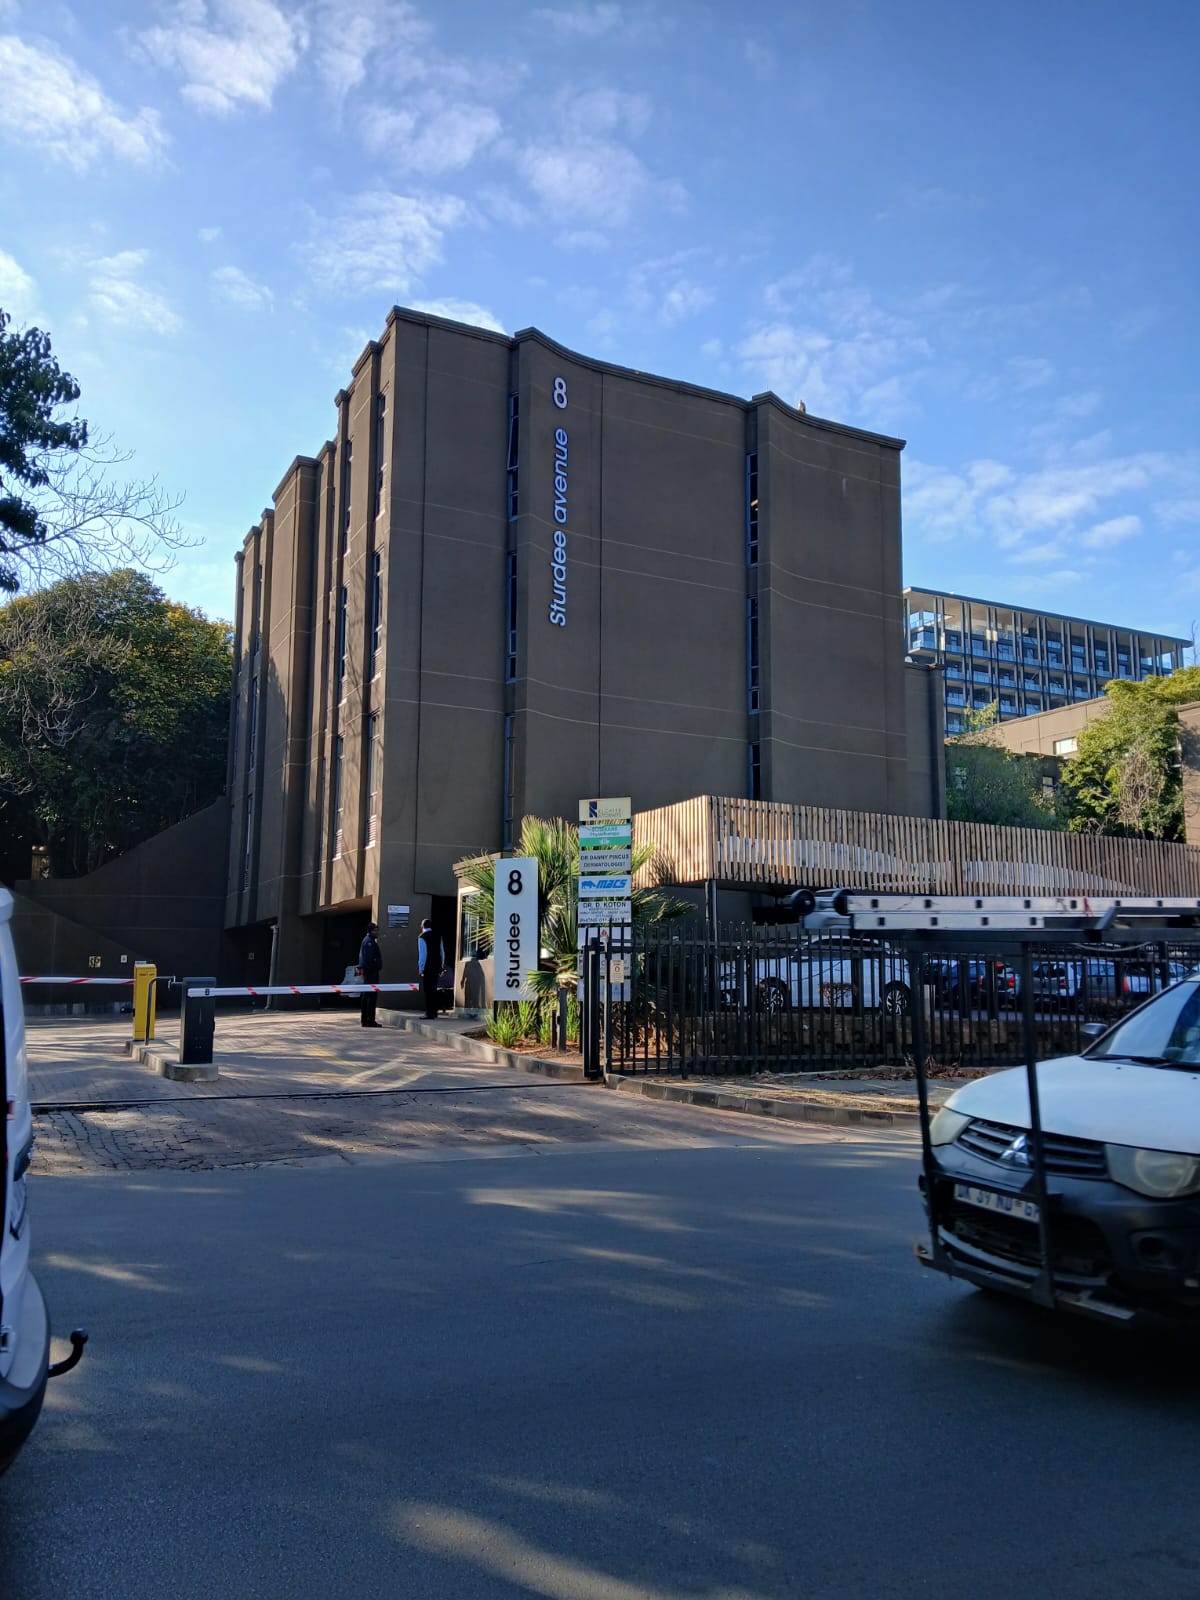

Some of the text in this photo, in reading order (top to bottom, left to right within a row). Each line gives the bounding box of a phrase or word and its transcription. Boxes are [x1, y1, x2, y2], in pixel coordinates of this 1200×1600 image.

[553, 377, 567, 408] 8
[549, 428, 568, 626] Sturdee avenue
[507, 869, 523, 896] 8
[506, 912, 521, 989] Sturdee
